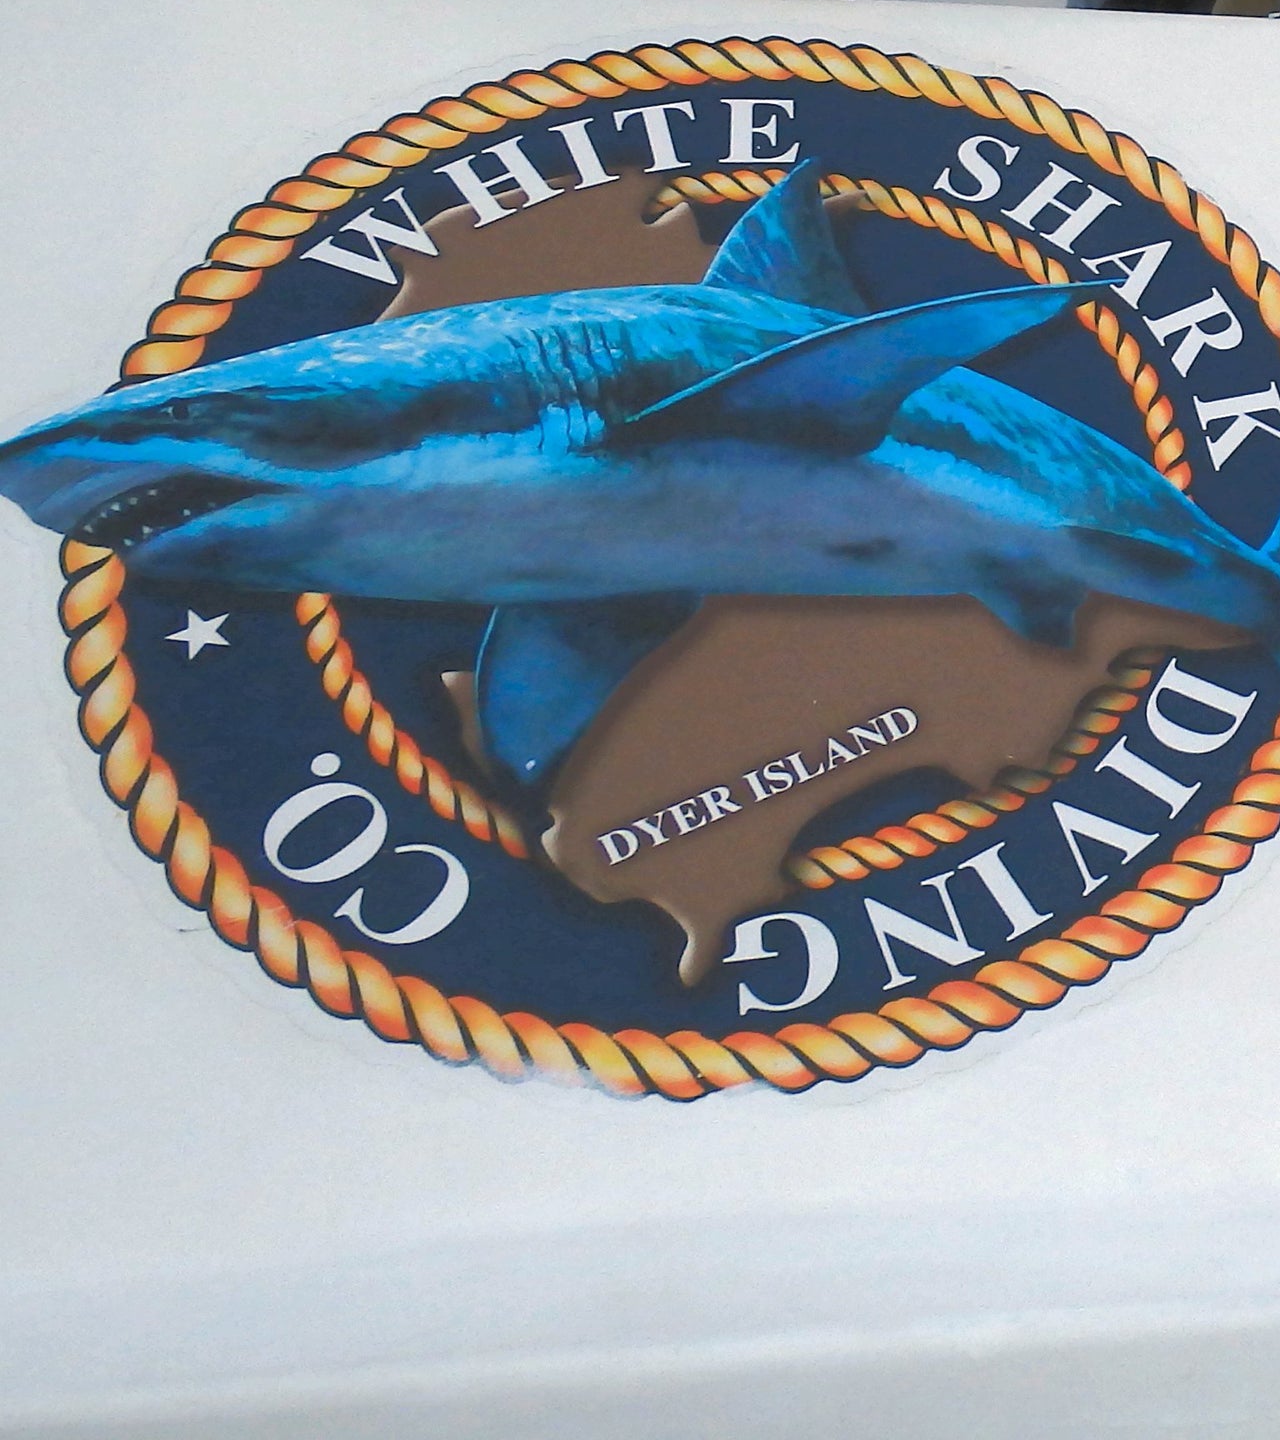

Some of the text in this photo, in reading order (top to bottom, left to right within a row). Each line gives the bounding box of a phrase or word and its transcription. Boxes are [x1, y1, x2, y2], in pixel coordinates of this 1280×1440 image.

[300, 97, 801, 286] WHITE
[262, 657, 1259, 1017] DIVING CO.
[596, 706, 918, 867] DYER ISLAND
